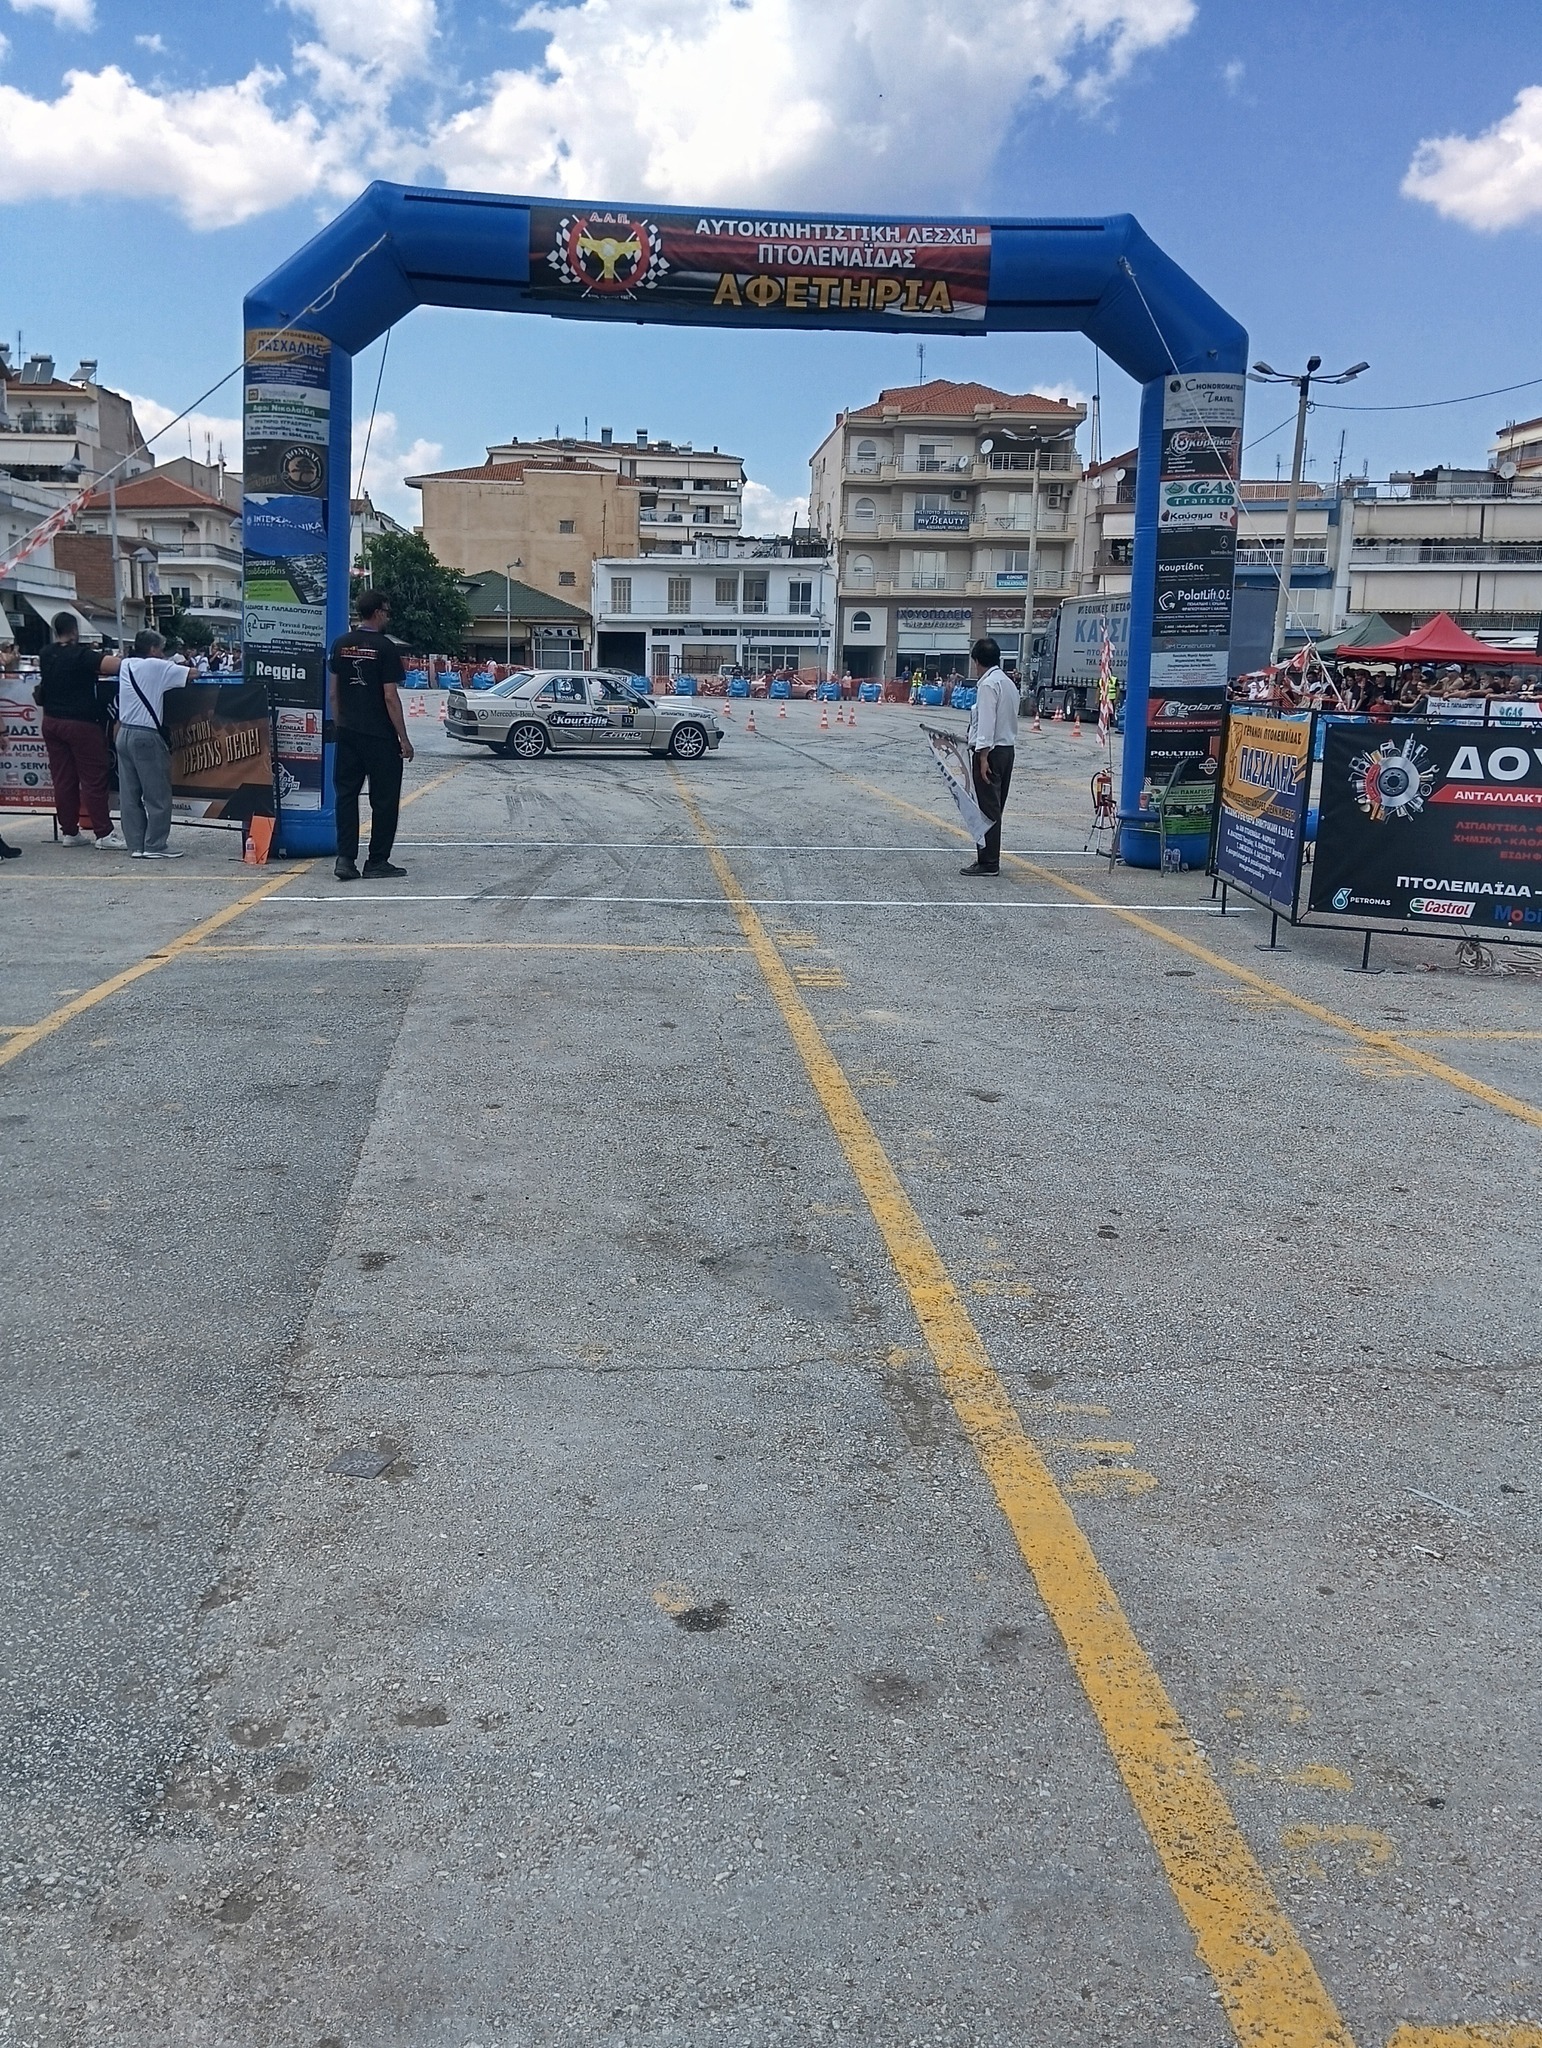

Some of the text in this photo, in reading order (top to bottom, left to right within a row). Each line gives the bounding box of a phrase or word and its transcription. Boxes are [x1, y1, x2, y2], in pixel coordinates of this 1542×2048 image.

[695, 218, 978, 245] ΑΥΤΟΚΙΝΗΤΙΣΤΙΚΗ ΛΕΣΧΗ
[758, 243, 917, 269] ΠΤΟΛΕΜΑΪΔΑΣ
[712, 273, 954, 313] ΑΦΕΤΗΡΙΑ
[1188, 481, 1236, 495] GAS
[1174, 497, 1232, 505] Transfer
[1170, 512, 1213, 521] Καύσιμα
[1158, 562, 1204, 573] Κουρτίδης
[256, 660, 307, 681] Reggia
[490, 710, 535, 718] Mercedes-Benz
[557, 716, 609, 725] Kourtidis
[187, 719, 212, 744] STORY
[183, 727, 261, 776] BEGINS HERE!
[1239, 745, 1298, 795] ΠΑΣΧΑΛΗΣ
[1455, 821, 1527, 833] ΛΙΠΑΝΤΙΚΑ
[1453, 834, 1502, 845] ΧΗΜΙΚΑ
[1500, 851, 1531, 860] ΕΙΔΗ
[1396, 875, 1532, 898] ΠΤΟΛΕΜΑΪΔΑ
[1350, 896, 1392, 907] PETRONAS
[1424, 900, 1471, 916] Castrol
